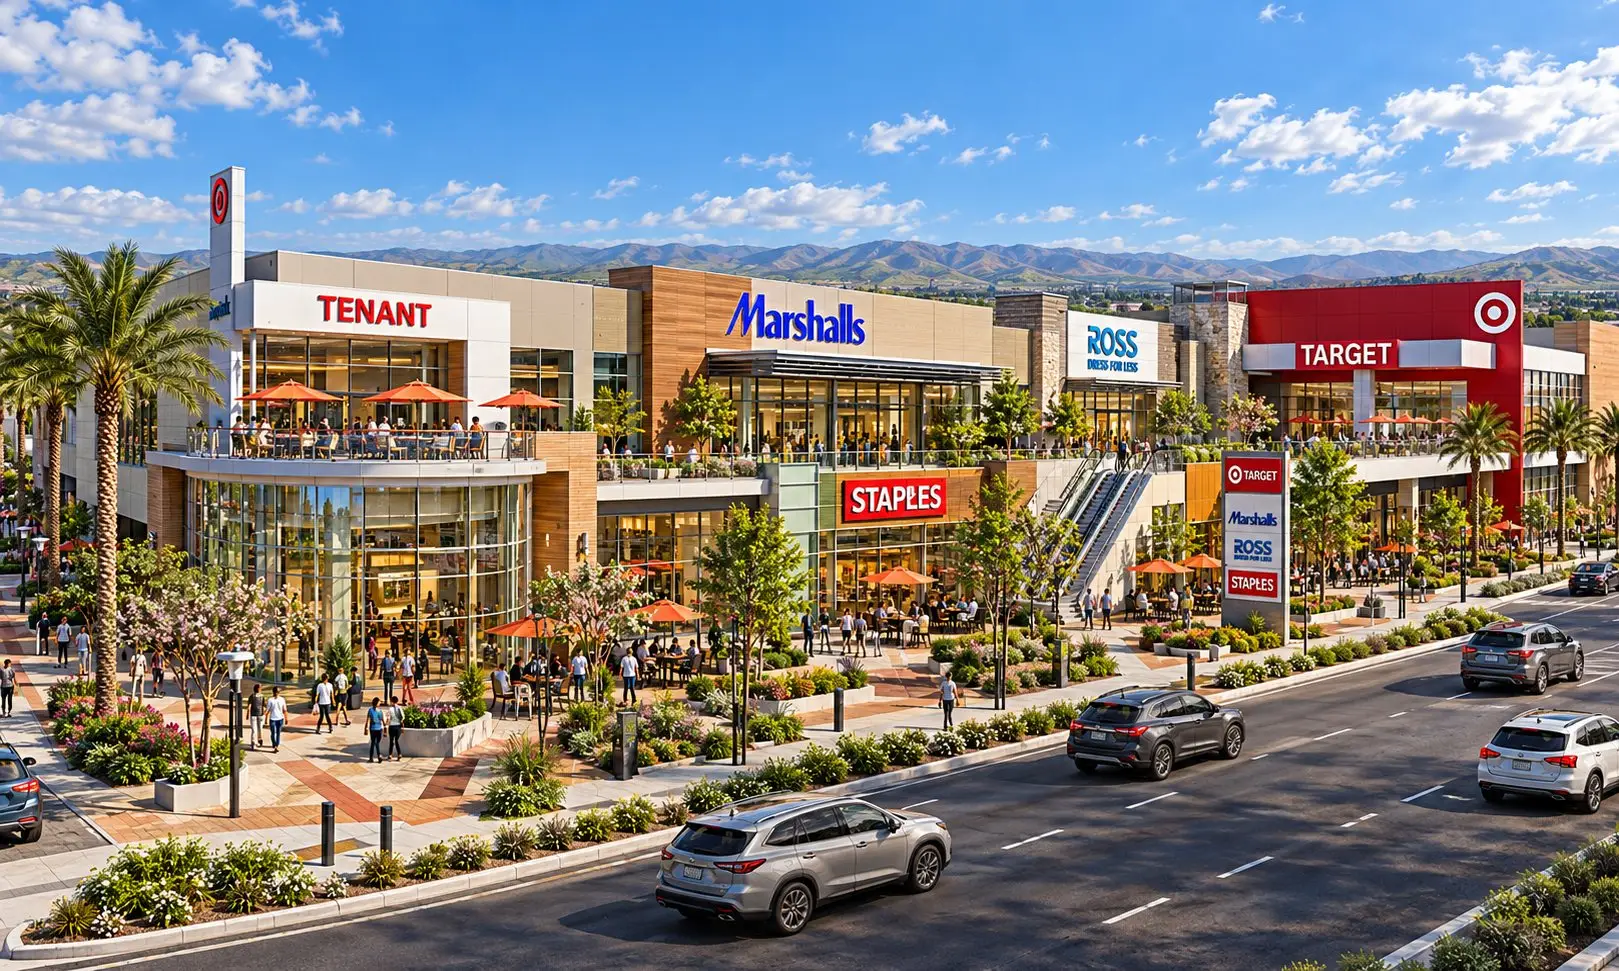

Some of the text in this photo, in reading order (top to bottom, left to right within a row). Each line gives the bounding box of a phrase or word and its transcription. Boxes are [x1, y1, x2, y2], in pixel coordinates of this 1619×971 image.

[317, 295, 432, 328] TENANT
[725, 292, 866, 346] Marshalls
[1087, 325, 1138, 359] ROSS
[1301, 343, 1392, 366] TARGET
[1243, 470, 1278, 481] TARGET
[851, 484, 942, 513] STAPLES
[1228, 511, 1278, 527] Marshalls
[1234, 539, 1273, 556] ROSS
[1231, 576, 1274, 592] STAPLES
